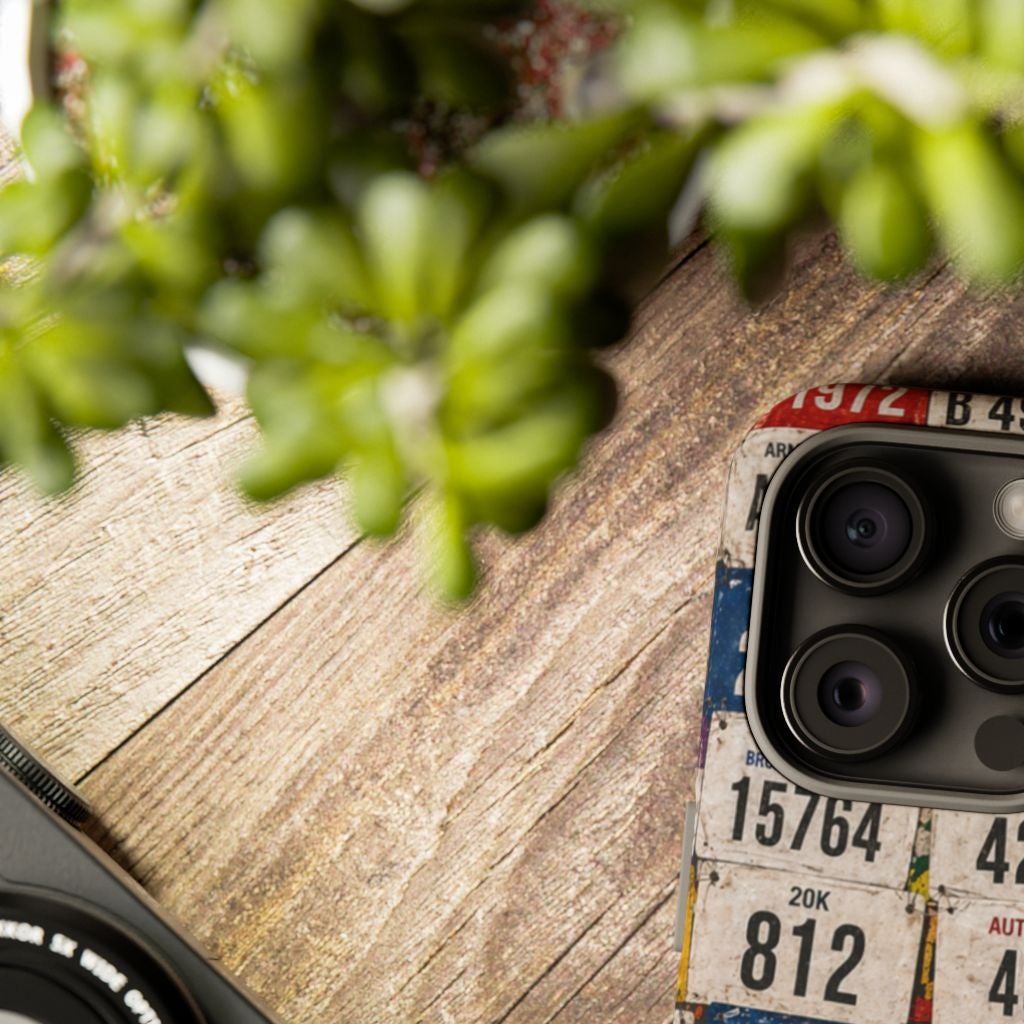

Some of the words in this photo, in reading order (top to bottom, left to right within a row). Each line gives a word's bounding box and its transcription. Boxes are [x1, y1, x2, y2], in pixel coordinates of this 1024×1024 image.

[946, 393, 973, 426] B
[731, 776, 882, 863] 15764
[788, 886, 831, 911] 20K
[740, 910, 866, 1006] 812
